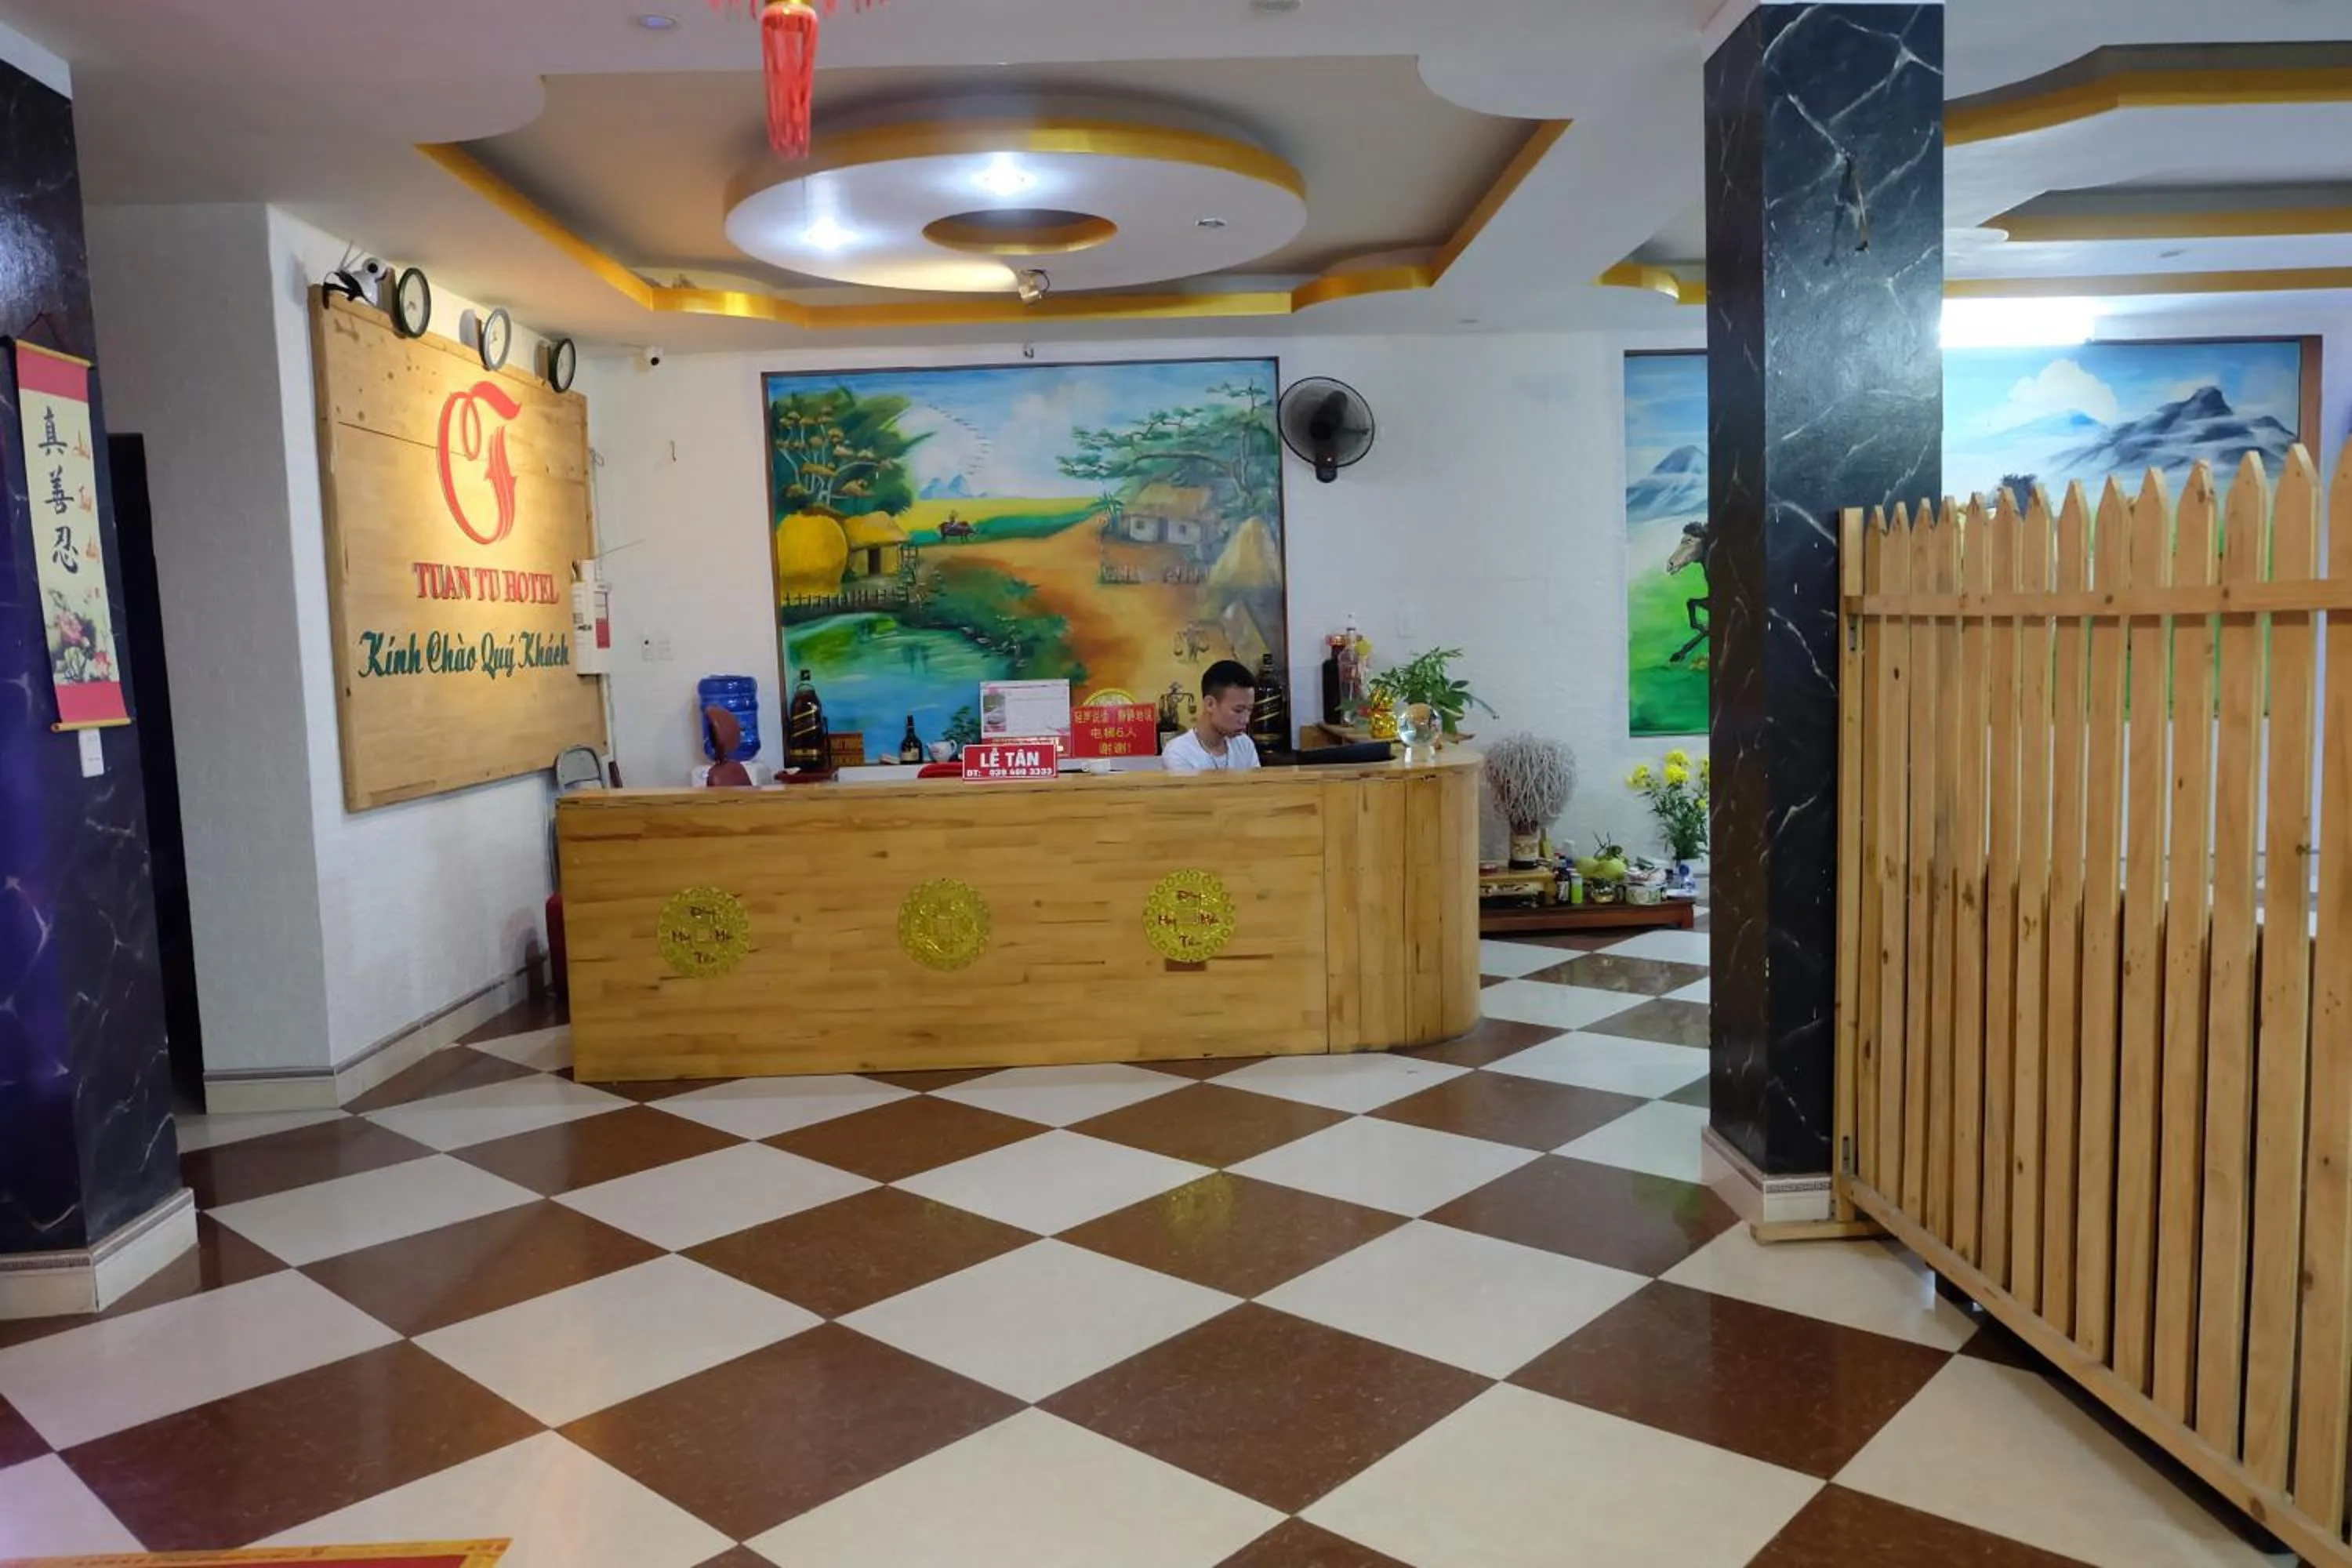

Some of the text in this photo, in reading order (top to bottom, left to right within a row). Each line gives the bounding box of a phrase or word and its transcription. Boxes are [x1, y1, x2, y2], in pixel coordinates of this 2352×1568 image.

[38, 405, 79, 574] 真善忍
[412, 562, 560, 604] TUAN TU HOTEL
[358, 630, 570, 681] Kính Chào Quý Khách
[980, 747, 1040, 768] LÊ TÂN
